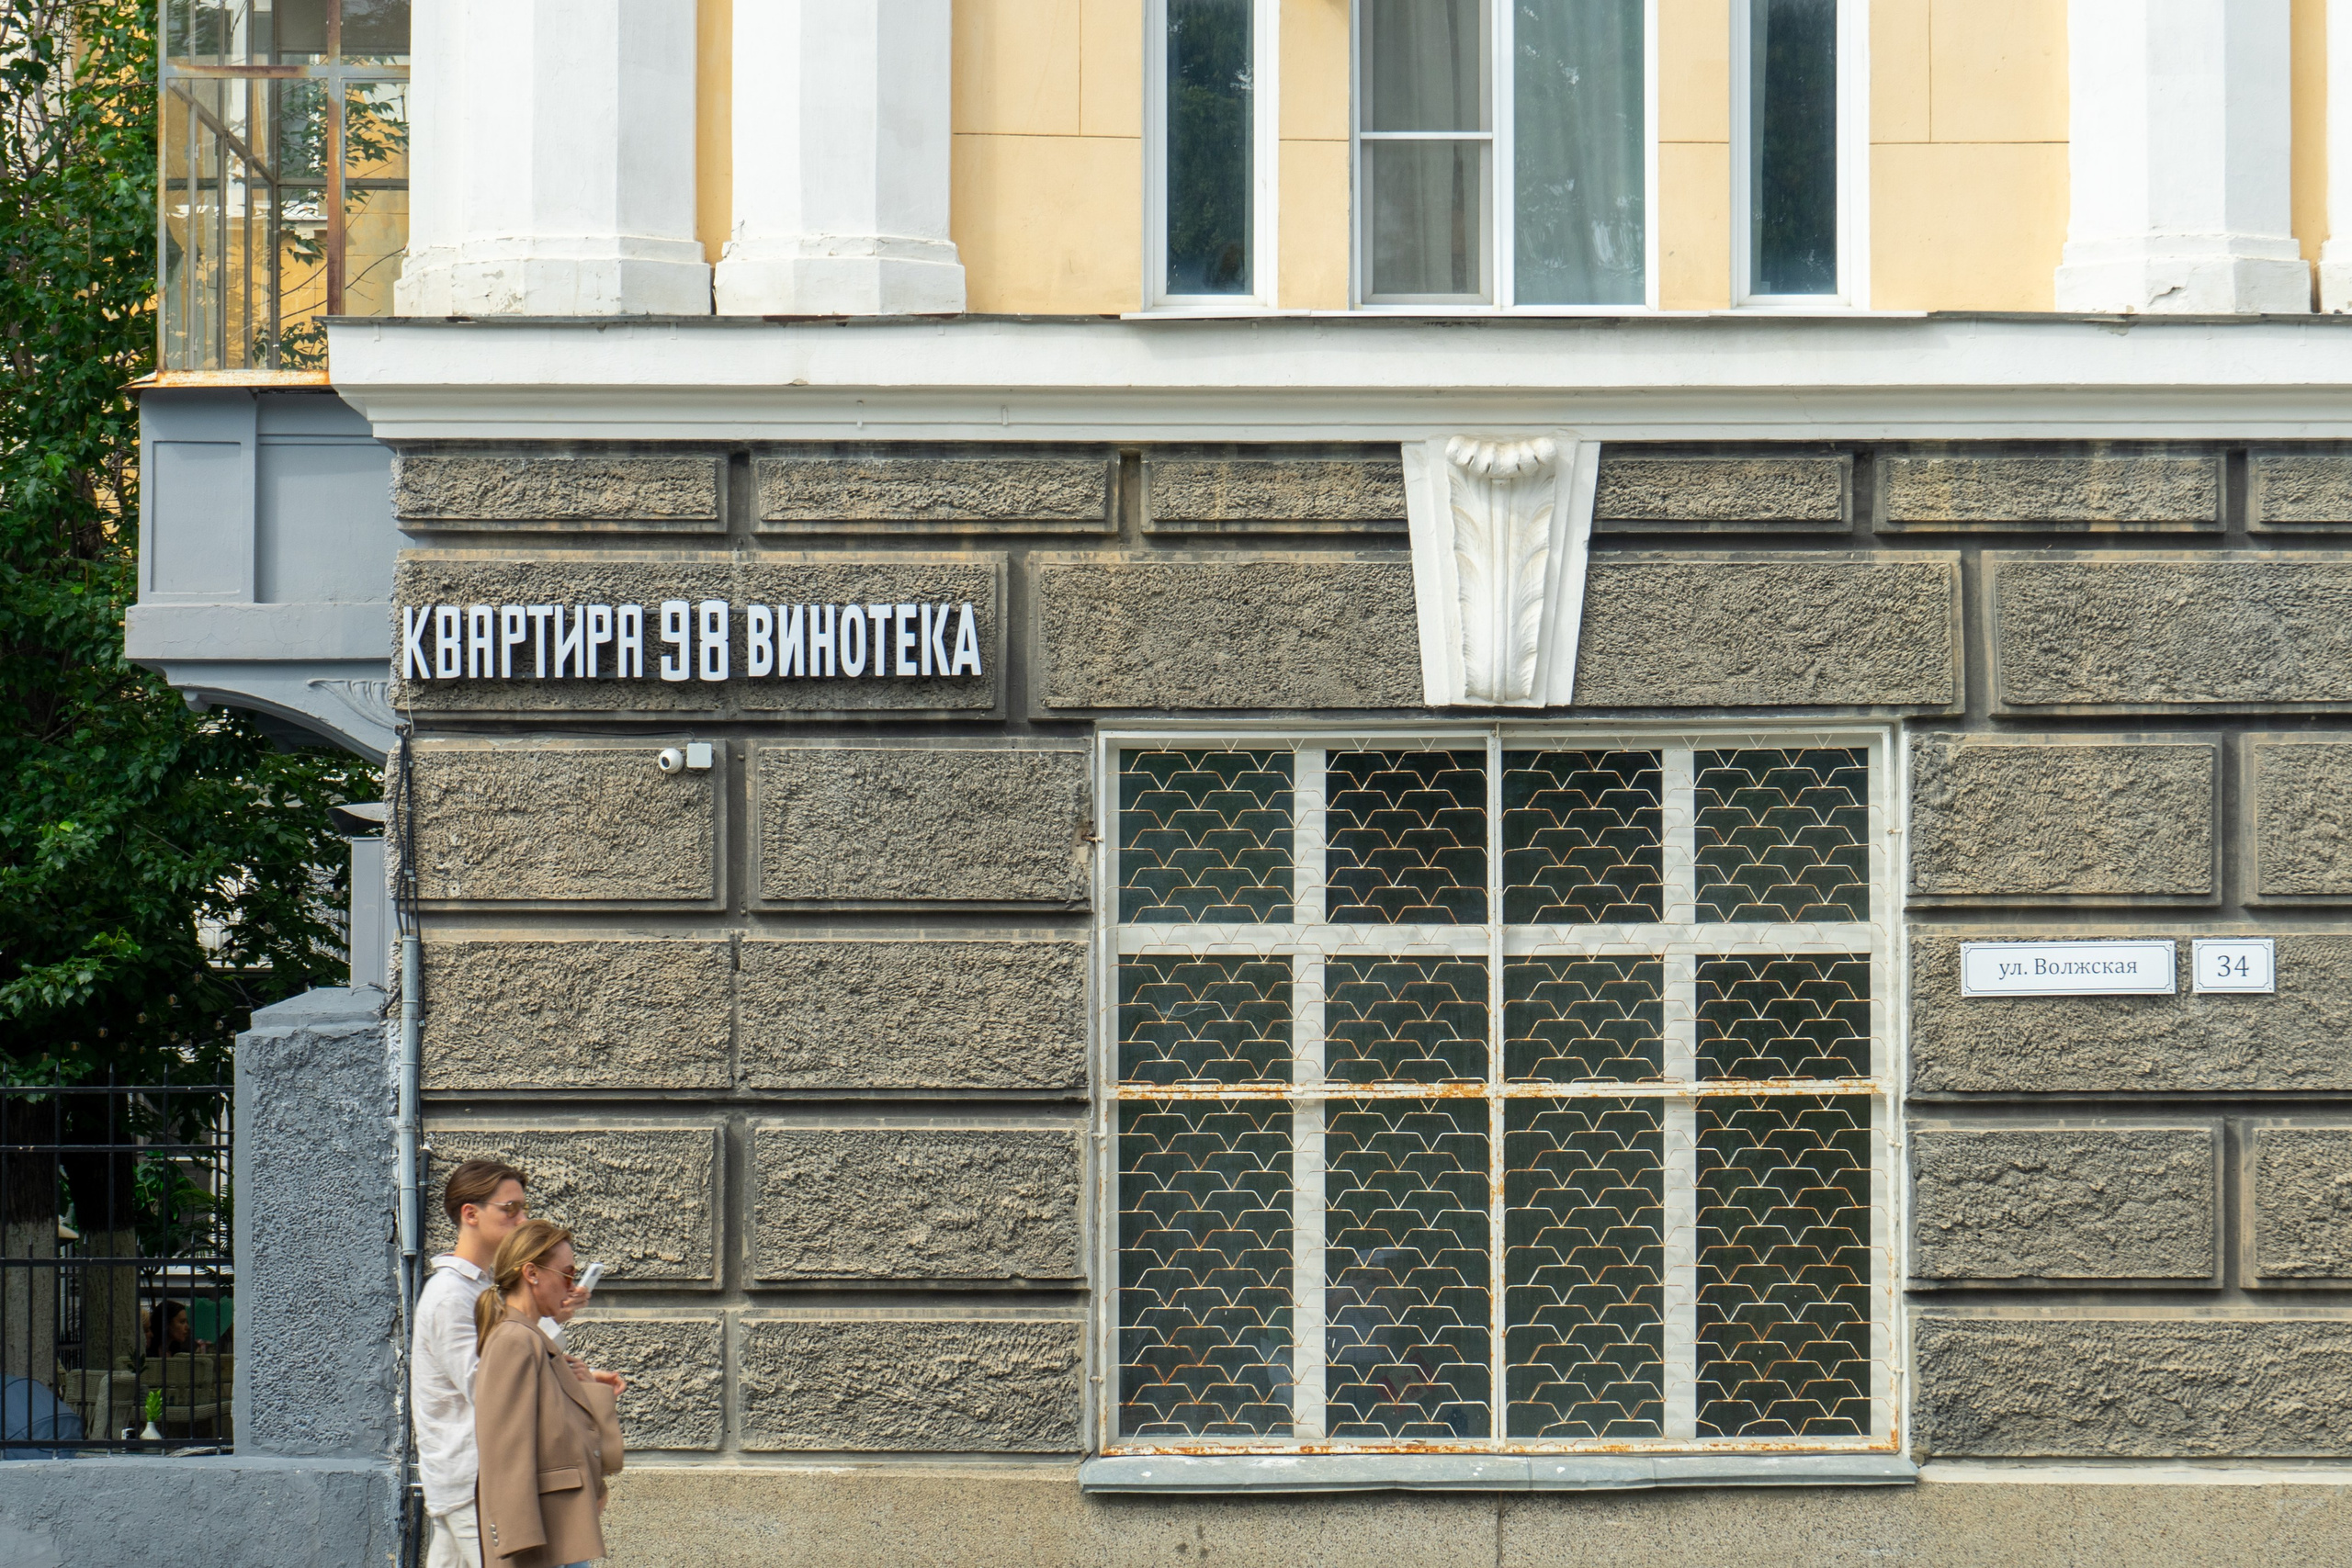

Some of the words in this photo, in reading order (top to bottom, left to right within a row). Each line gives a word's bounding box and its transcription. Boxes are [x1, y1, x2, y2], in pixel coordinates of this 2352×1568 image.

[402, 605, 644, 680] КВАРТИРА
[661, 600, 729, 682] 98
[747, 604, 982, 678] ВИНОТЕКА
[1998, 960, 2029, 980] ул.
[2034, 957, 2138, 976] Волжская
[2217, 955, 2250, 977] 34
